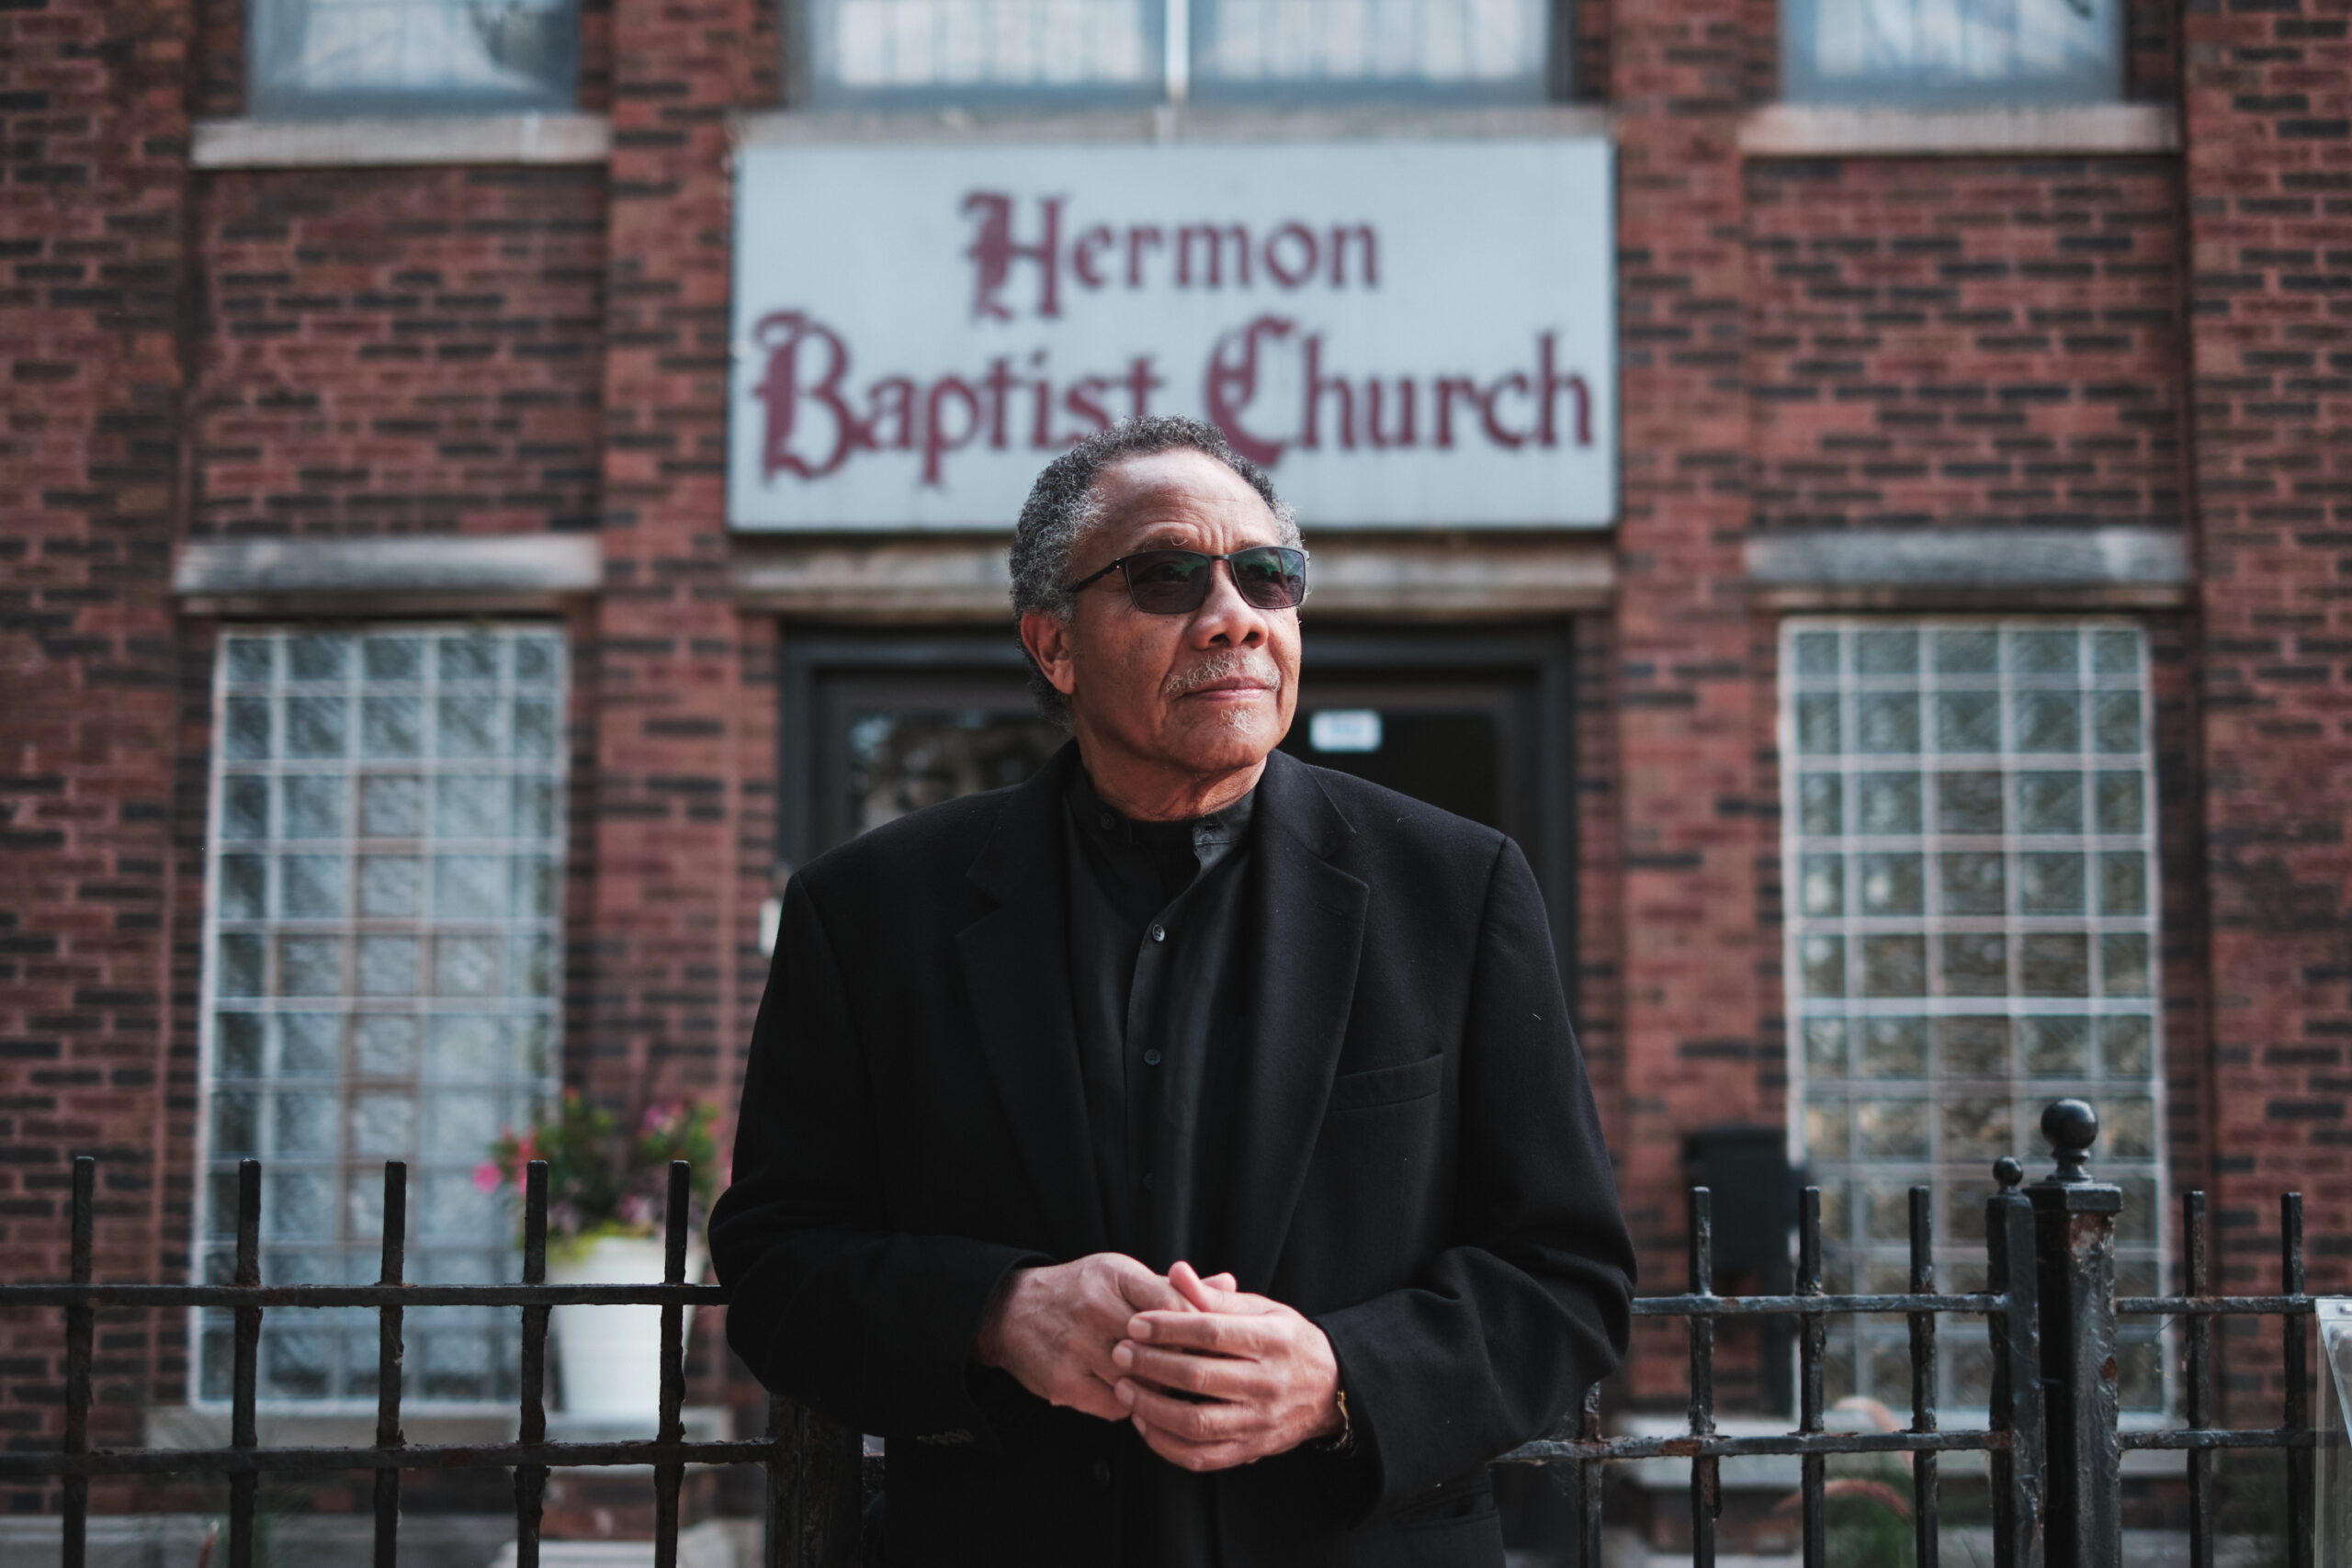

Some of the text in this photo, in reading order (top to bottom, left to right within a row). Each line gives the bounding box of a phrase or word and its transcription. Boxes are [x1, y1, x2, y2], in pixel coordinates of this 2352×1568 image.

[959, 189, 1382, 322] Hermon
[751, 310, 1595, 487] Baptist Church
